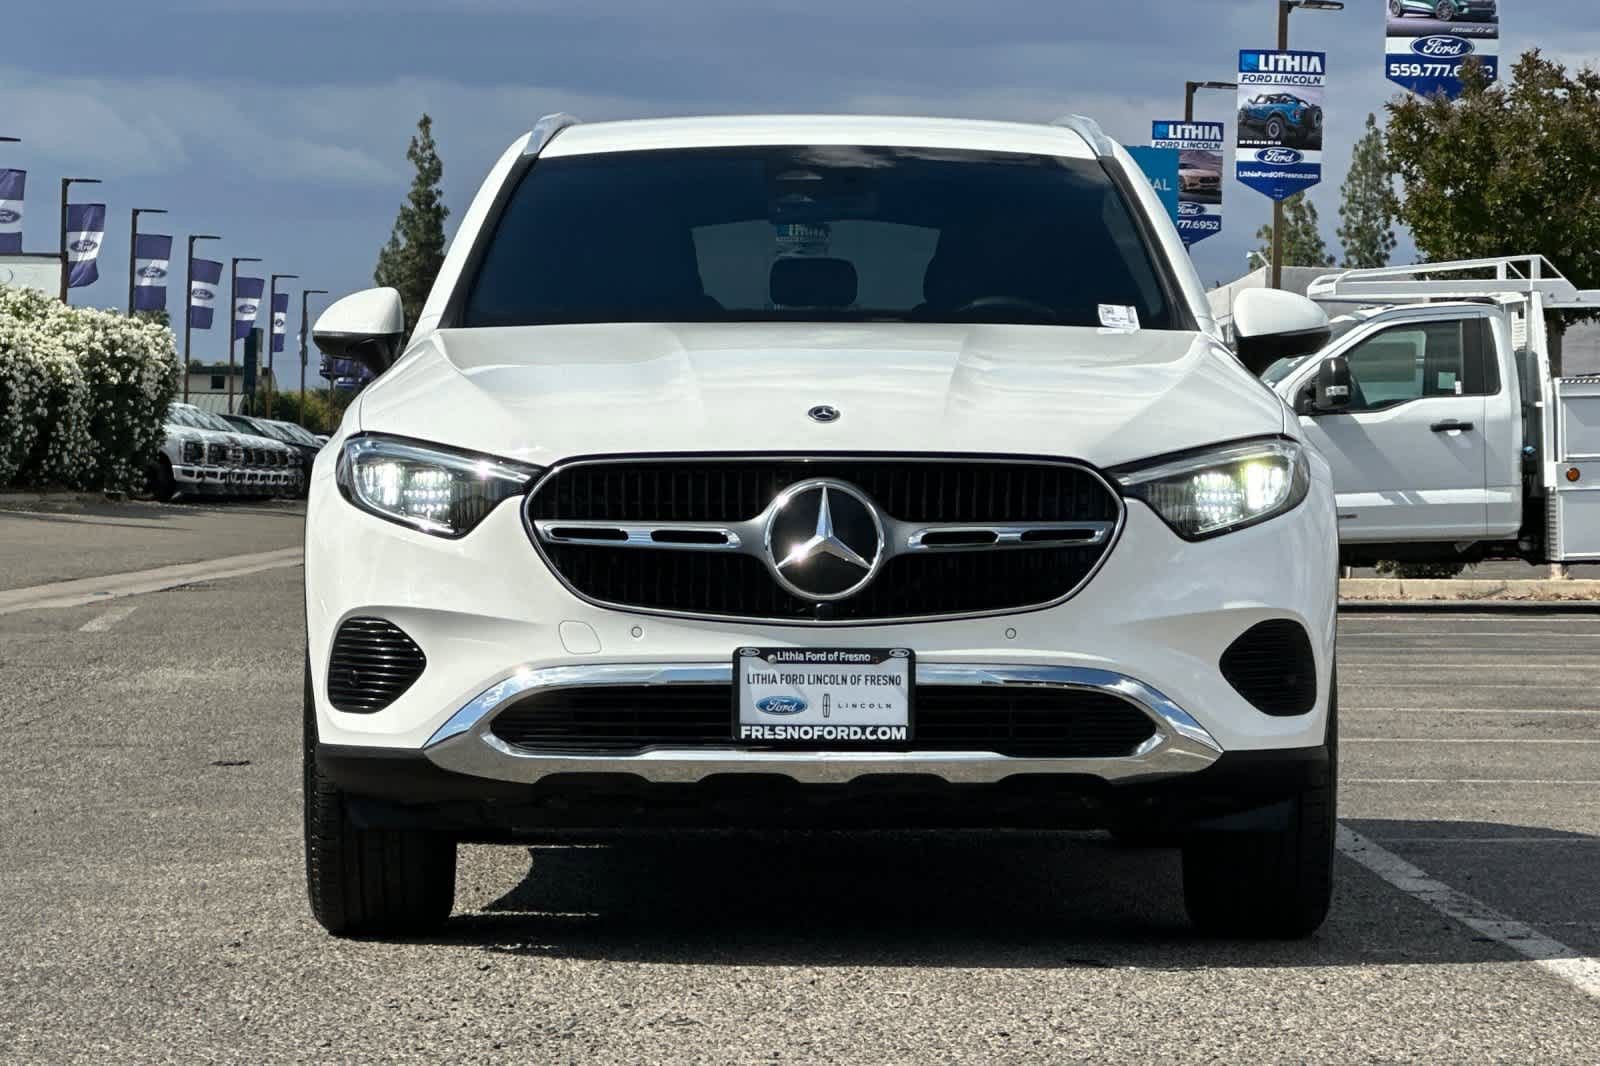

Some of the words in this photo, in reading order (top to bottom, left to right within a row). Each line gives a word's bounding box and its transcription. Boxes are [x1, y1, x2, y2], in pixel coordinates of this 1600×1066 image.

[1423, 38, 1462, 55] Ford
[1258, 54, 1323, 73] LITHIA
[1390, 63, 1494, 78] 559.777.62
[1242, 74, 1272, 83] FORD
[1274, 75, 1322, 84] LINCOLN
[1168, 124, 1222, 140] LITHIA
[1264, 149, 1295, 162] Ford
[1149, 178, 1172, 191] AL
[777, 651, 804, 661] Lithia
[806, 652, 827, 661] Ford
[828, 652, 838, 661] of
[839, 652, 871, 662] Fresno
[747, 673, 777, 685] LITHIA
[780, 674, 805, 685] FORD
[807, 674, 848, 686] LINCOLN
[850, 674, 862, 686] OF
[864, 675, 902, 686] FRESNO
[766, 699, 797, 713] Ford
[741, 726, 906, 740] FRESNOFORD.COM
